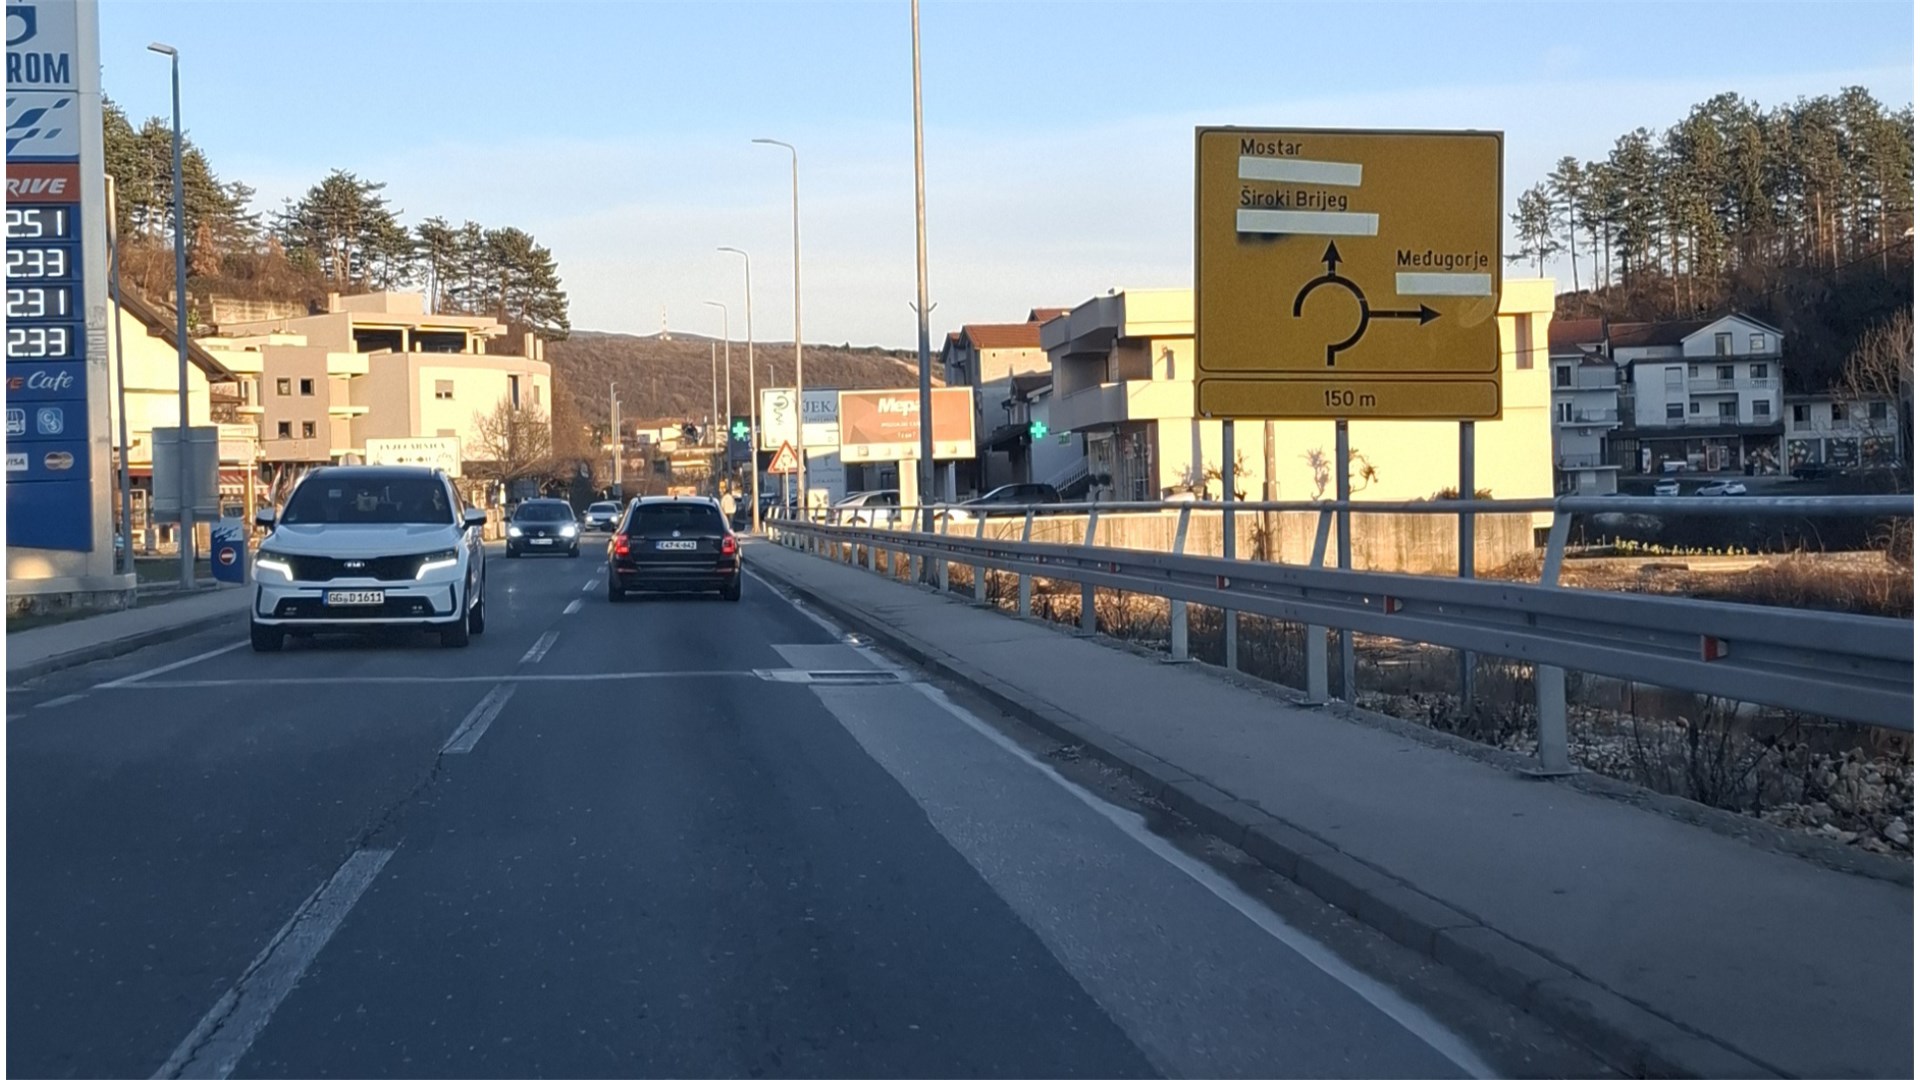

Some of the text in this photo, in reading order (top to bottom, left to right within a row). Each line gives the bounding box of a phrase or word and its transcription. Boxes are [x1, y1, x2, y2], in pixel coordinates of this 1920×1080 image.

[1240, 139, 1303, 155] Mostar
[1240, 185, 1348, 211] Široki Brijeg
[1397, 249, 1488, 271] Međugorje
[27, 370, 74, 391] Cafe
[1325, 390, 1376, 406] 150 m
